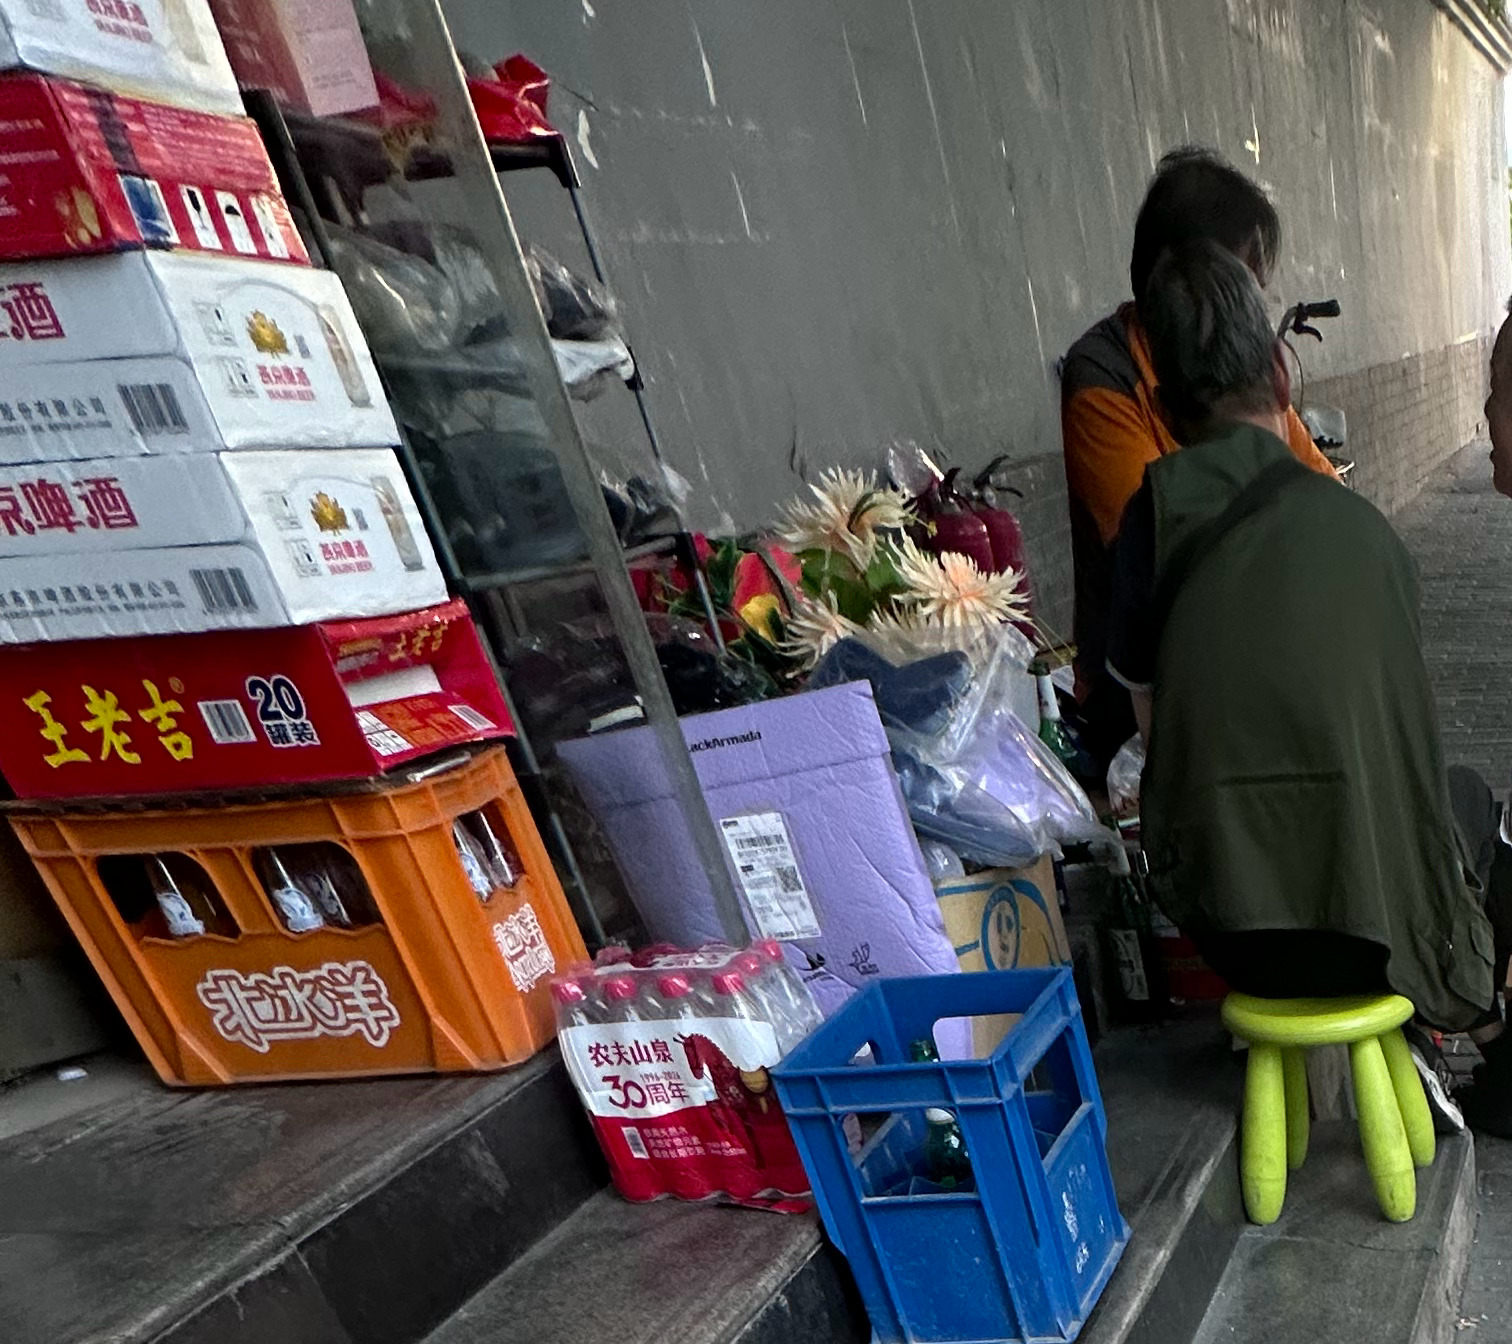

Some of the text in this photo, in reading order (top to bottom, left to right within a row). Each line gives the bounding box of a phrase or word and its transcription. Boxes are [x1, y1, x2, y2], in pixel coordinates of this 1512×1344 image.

[0, 282, 66, 341] 酒
[244, 673, 307, 722] 20
[22, 678, 194, 768] 王老吉
[264, 719, 320, 748] 罐装
[689, 731, 762, 753] ackArmada
[196, 960, 401, 1054] 北冰洋
[587, 1038, 675, 1068] 农夫山泉
